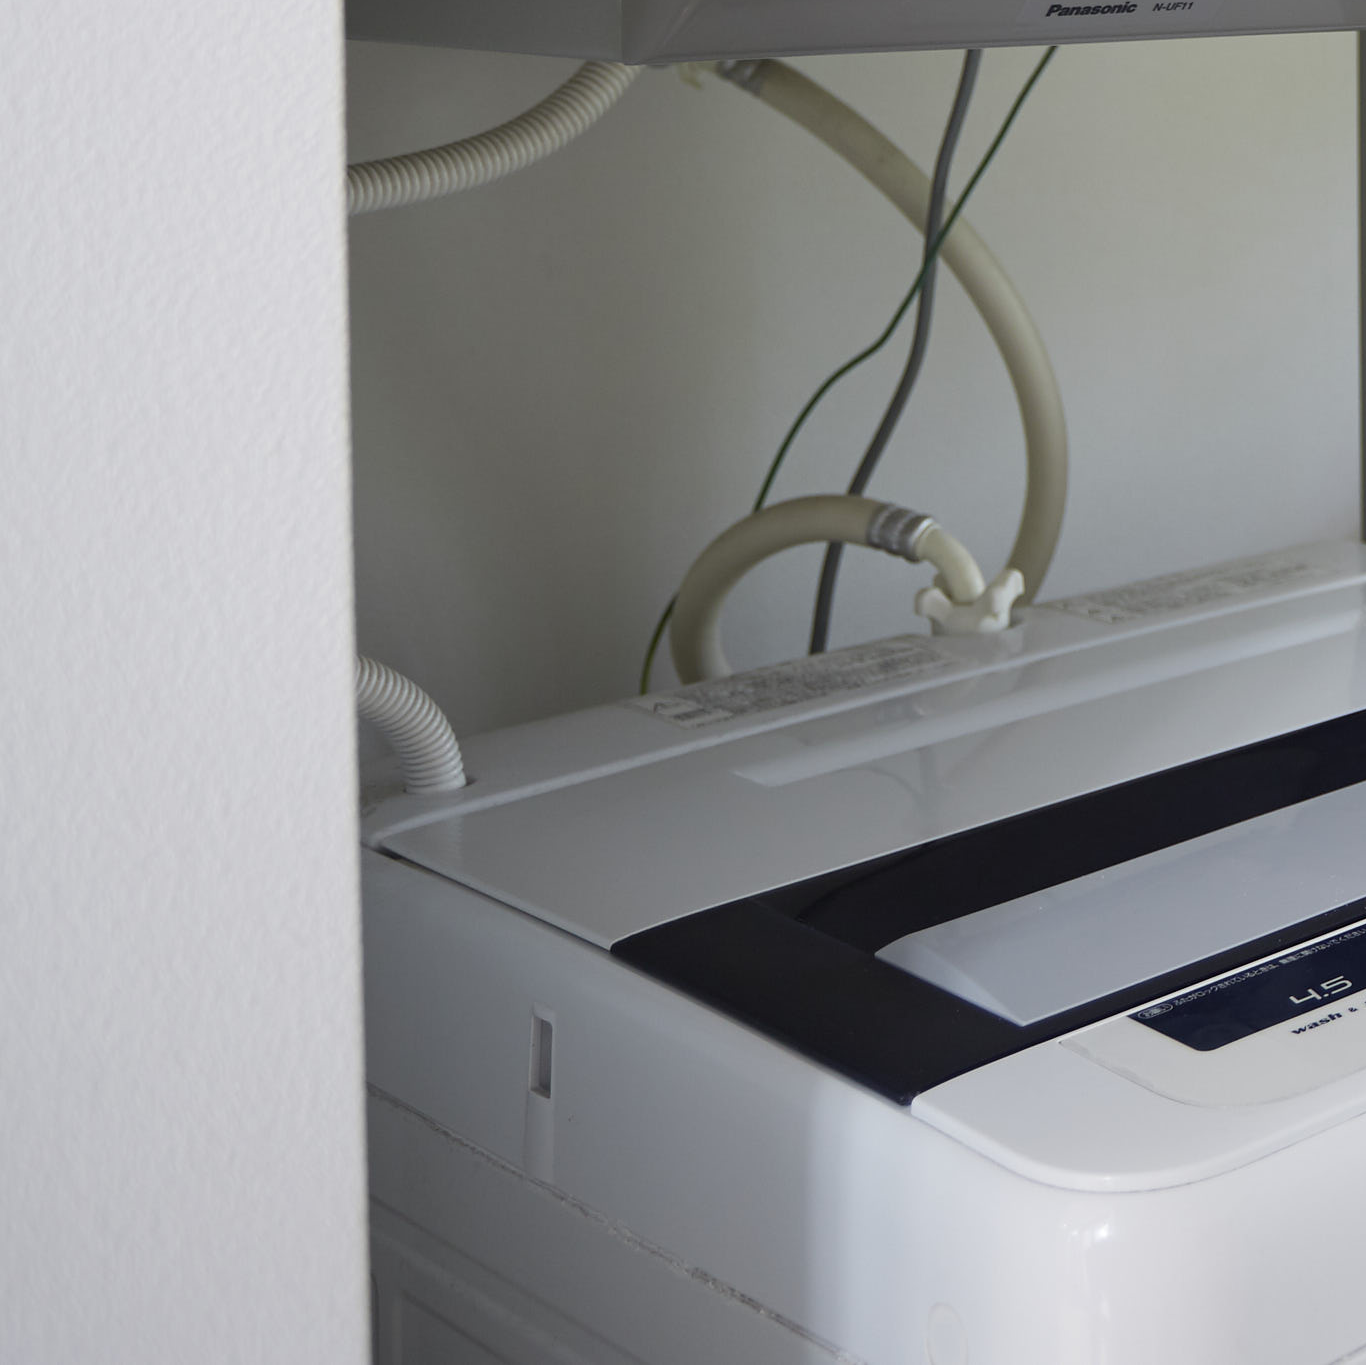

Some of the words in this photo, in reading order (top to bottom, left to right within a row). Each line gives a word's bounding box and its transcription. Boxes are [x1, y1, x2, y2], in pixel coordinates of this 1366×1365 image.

[1045, 1, 1138, 17] Panasonic
[1153, 1, 1194, 12] N-UF11
[1289, 975, 1353, 1004] 4.5
[1291, 1012, 1343, 1034] wash
